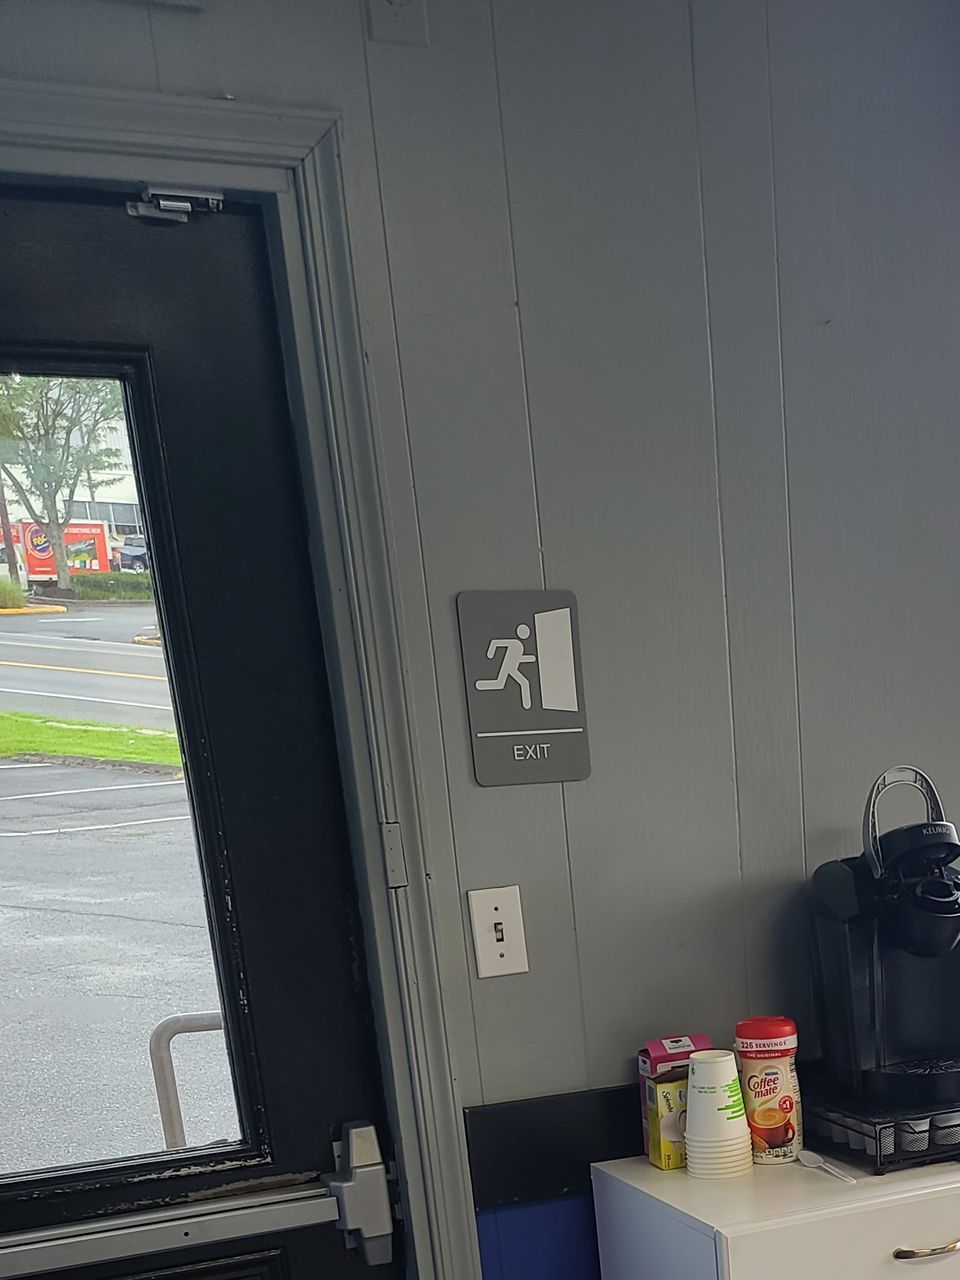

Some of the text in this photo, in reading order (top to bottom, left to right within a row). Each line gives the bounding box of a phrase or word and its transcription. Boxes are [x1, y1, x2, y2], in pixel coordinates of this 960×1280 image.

[513, 743, 551, 760] EXIT
[741, 1041, 787, 1049] 226 SERVINGS
[747, 1074, 779, 1092] Coffee
[754, 1086, 778, 1099] mate
